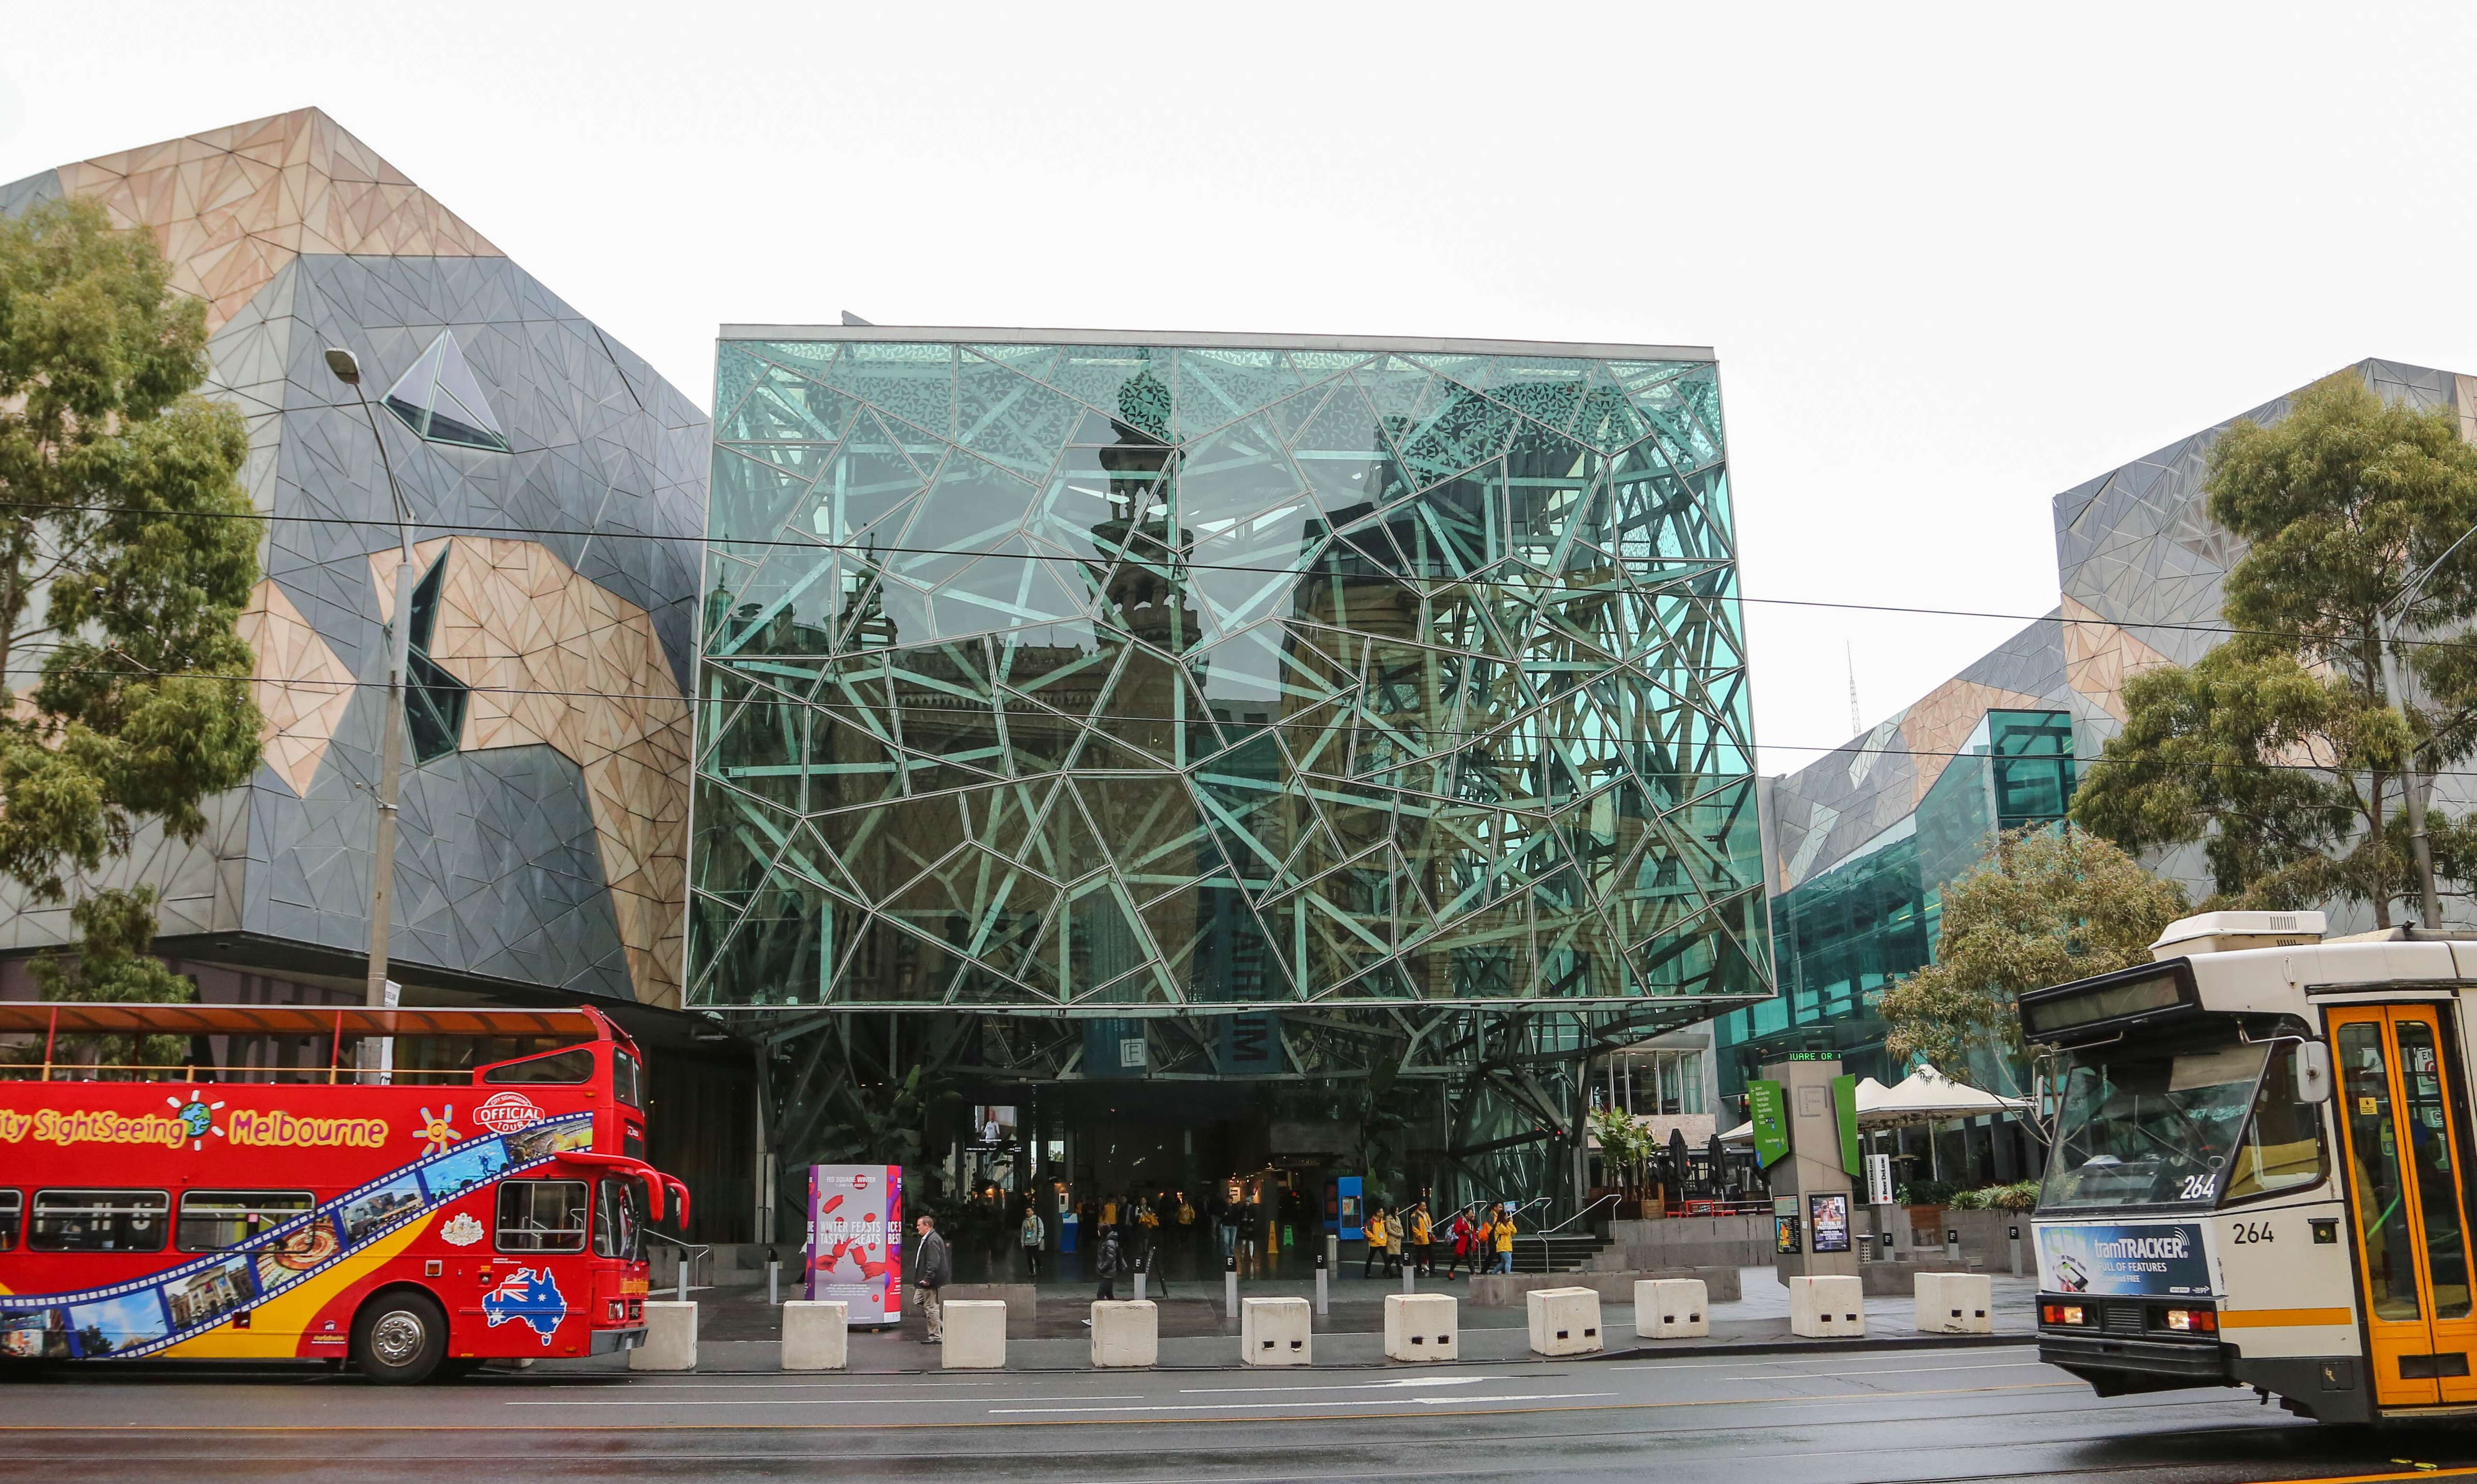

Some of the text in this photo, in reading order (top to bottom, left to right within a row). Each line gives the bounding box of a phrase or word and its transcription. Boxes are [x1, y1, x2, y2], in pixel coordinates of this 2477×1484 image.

[1821, 1052, 1833, 1060] OR
[480, 1107, 541, 1121] OFFICIAL
[33, 1108, 187, 1149] SightSeeing
[229, 1109, 388, 1148] Melbourne
[497, 1122, 524, 1131] TOUR
[2180, 1174, 2216, 1199] 264
[821, 1221, 848, 1233] WINTER
[851, 1221, 881, 1233] FEASTS
[2233, 1221, 2274, 1244] 264
[820, 1233, 846, 1245] TASTY
[850, 1233, 881, 1245] TREATS
[2099, 1262, 2115, 1273] FULL
[2116, 1262, 2127, 1272] OF
[2128, 1262, 2167, 1273] FEATURES
[2126, 1275, 2141, 1283] FREE
